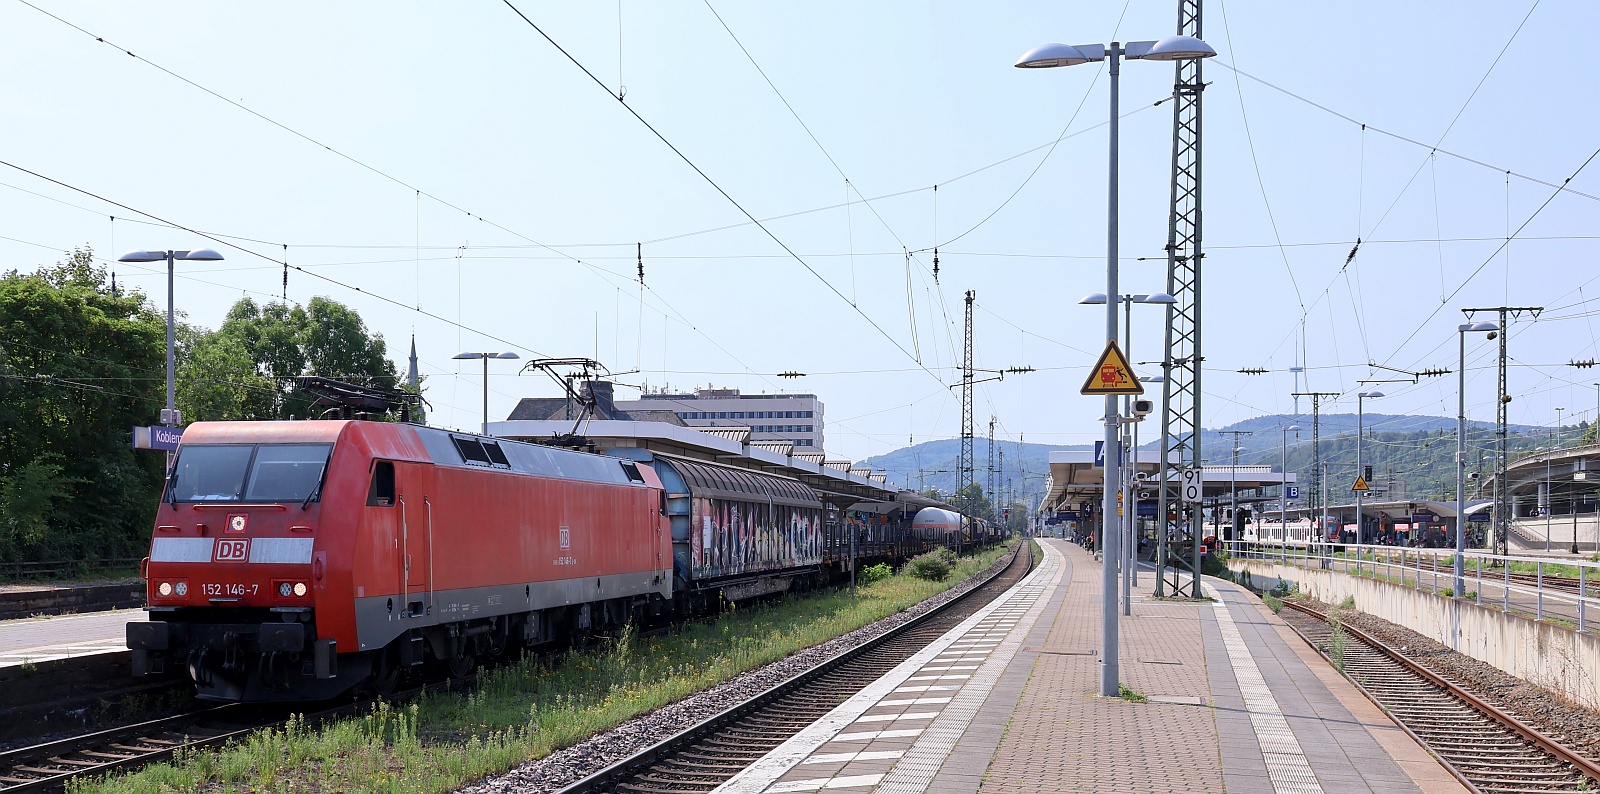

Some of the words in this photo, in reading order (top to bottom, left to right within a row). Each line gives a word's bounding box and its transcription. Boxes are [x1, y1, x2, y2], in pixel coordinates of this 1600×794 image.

[156, 429, 182, 444] Koblen
[1184, 470, 1200, 484] 91
[1186, 485, 1198, 500] 0
[1290, 487, 1298, 497] B
[1085, 504, 1091, 513] 4
[561, 530, 569, 547] DB
[219, 542, 245, 558] DB
[201, 583, 222, 595] 152
[225, 583, 259, 595] 146-7
